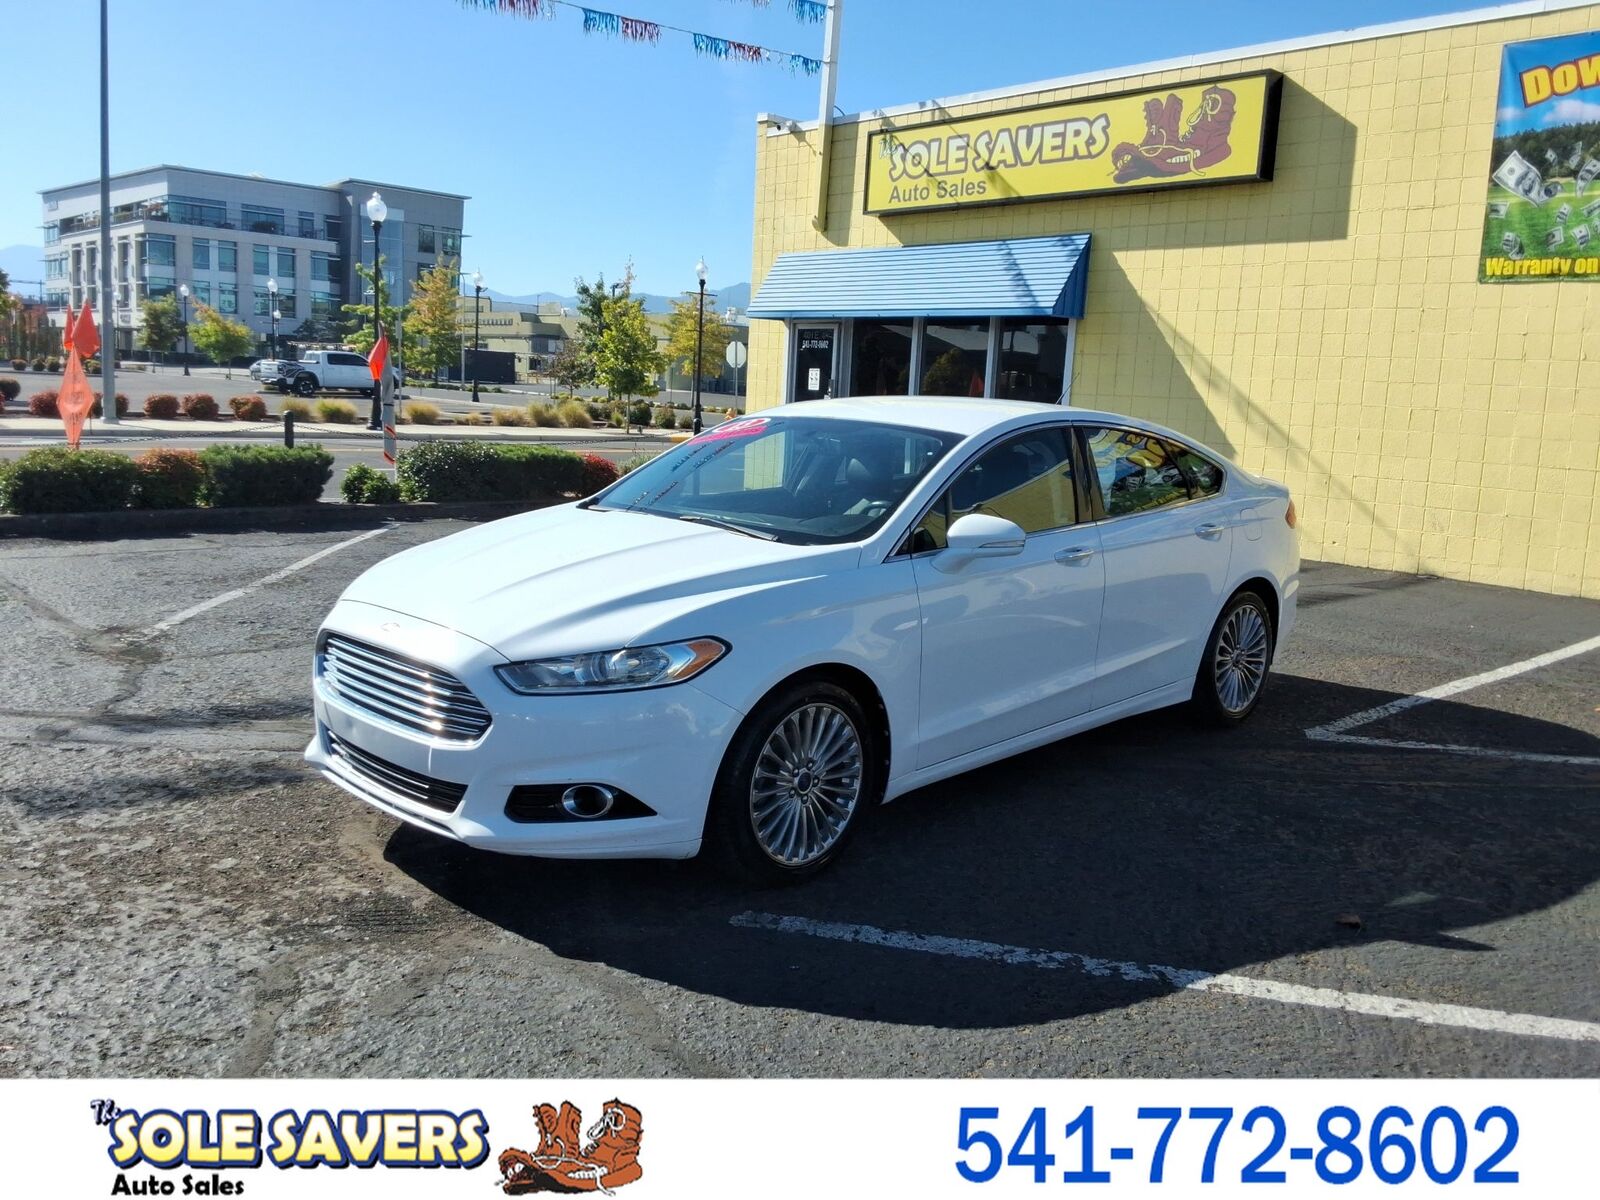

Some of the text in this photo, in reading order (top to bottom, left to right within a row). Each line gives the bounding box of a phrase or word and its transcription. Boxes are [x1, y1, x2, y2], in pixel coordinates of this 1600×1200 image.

[889, 113, 1111, 182] SOLE SAVERS
[889, 178, 987, 203] Auto Sales
[1486, 256, 1599, 276] Warranty on
